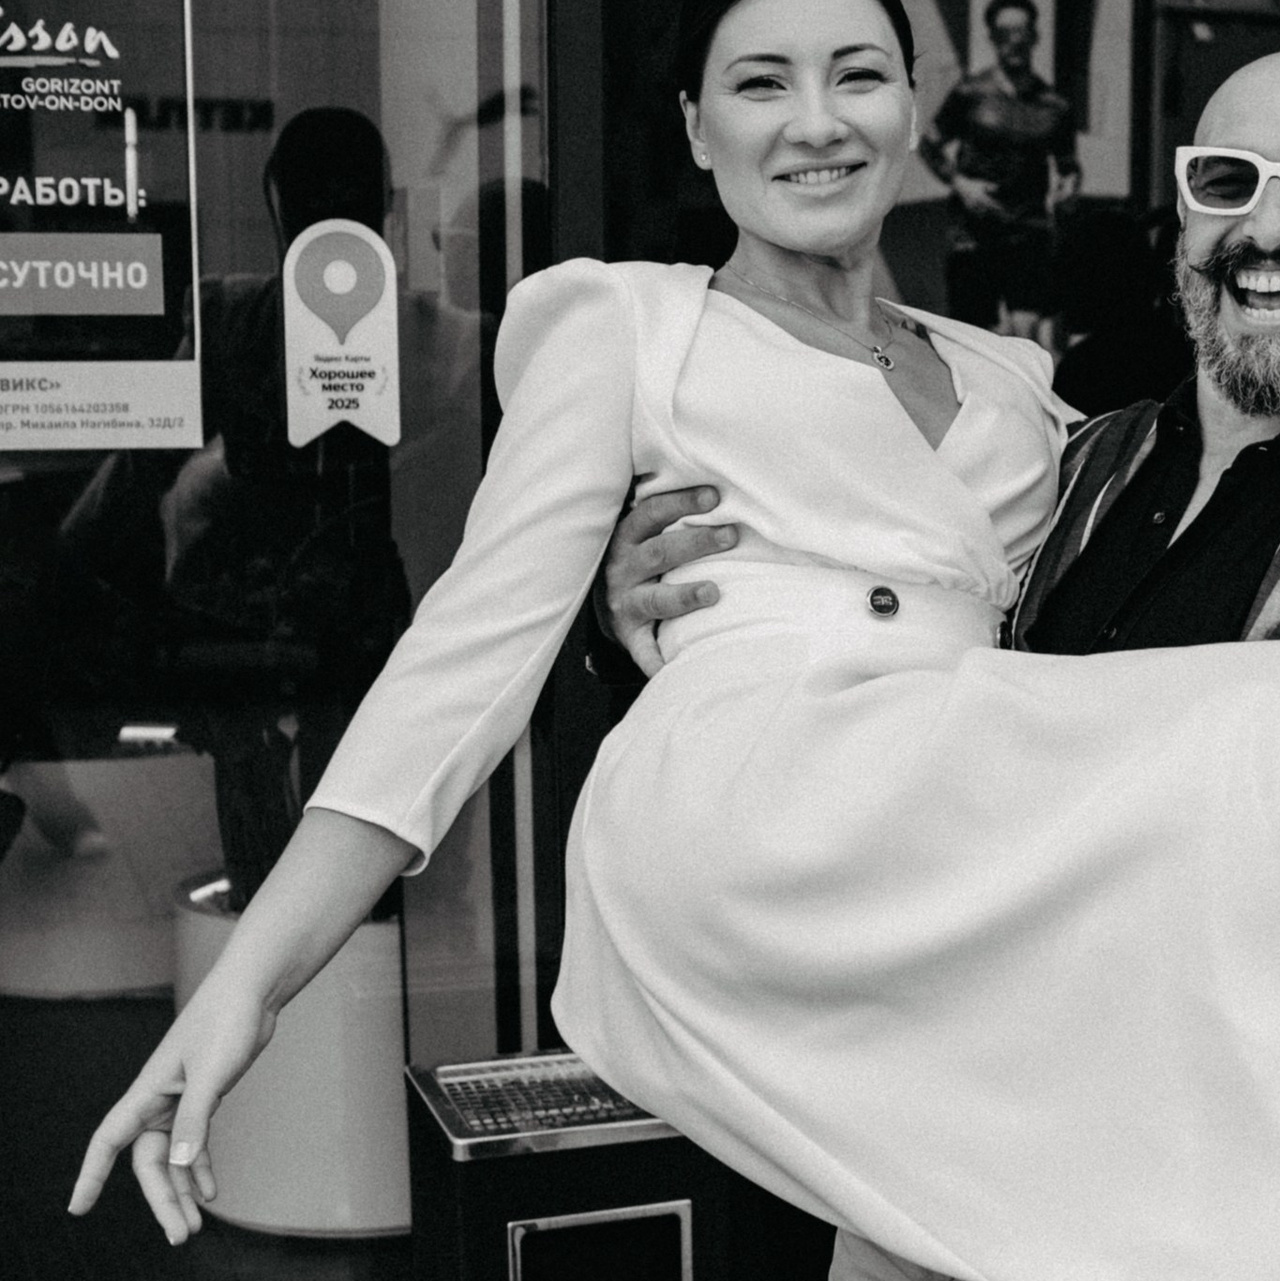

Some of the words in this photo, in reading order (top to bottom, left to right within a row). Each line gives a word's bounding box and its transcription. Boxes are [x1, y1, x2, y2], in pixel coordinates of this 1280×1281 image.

[0, 6, 119, 59] sson
[21, 77, 122, 95] GORIZONT
[0, 93, 122, 112] TOV-ON-DON
[309, 366, 376, 381] Хорошее
[321, 382, 365, 393] место
[327, 397, 360, 410] 2025
[20, 419, 77, 430] Михаила
